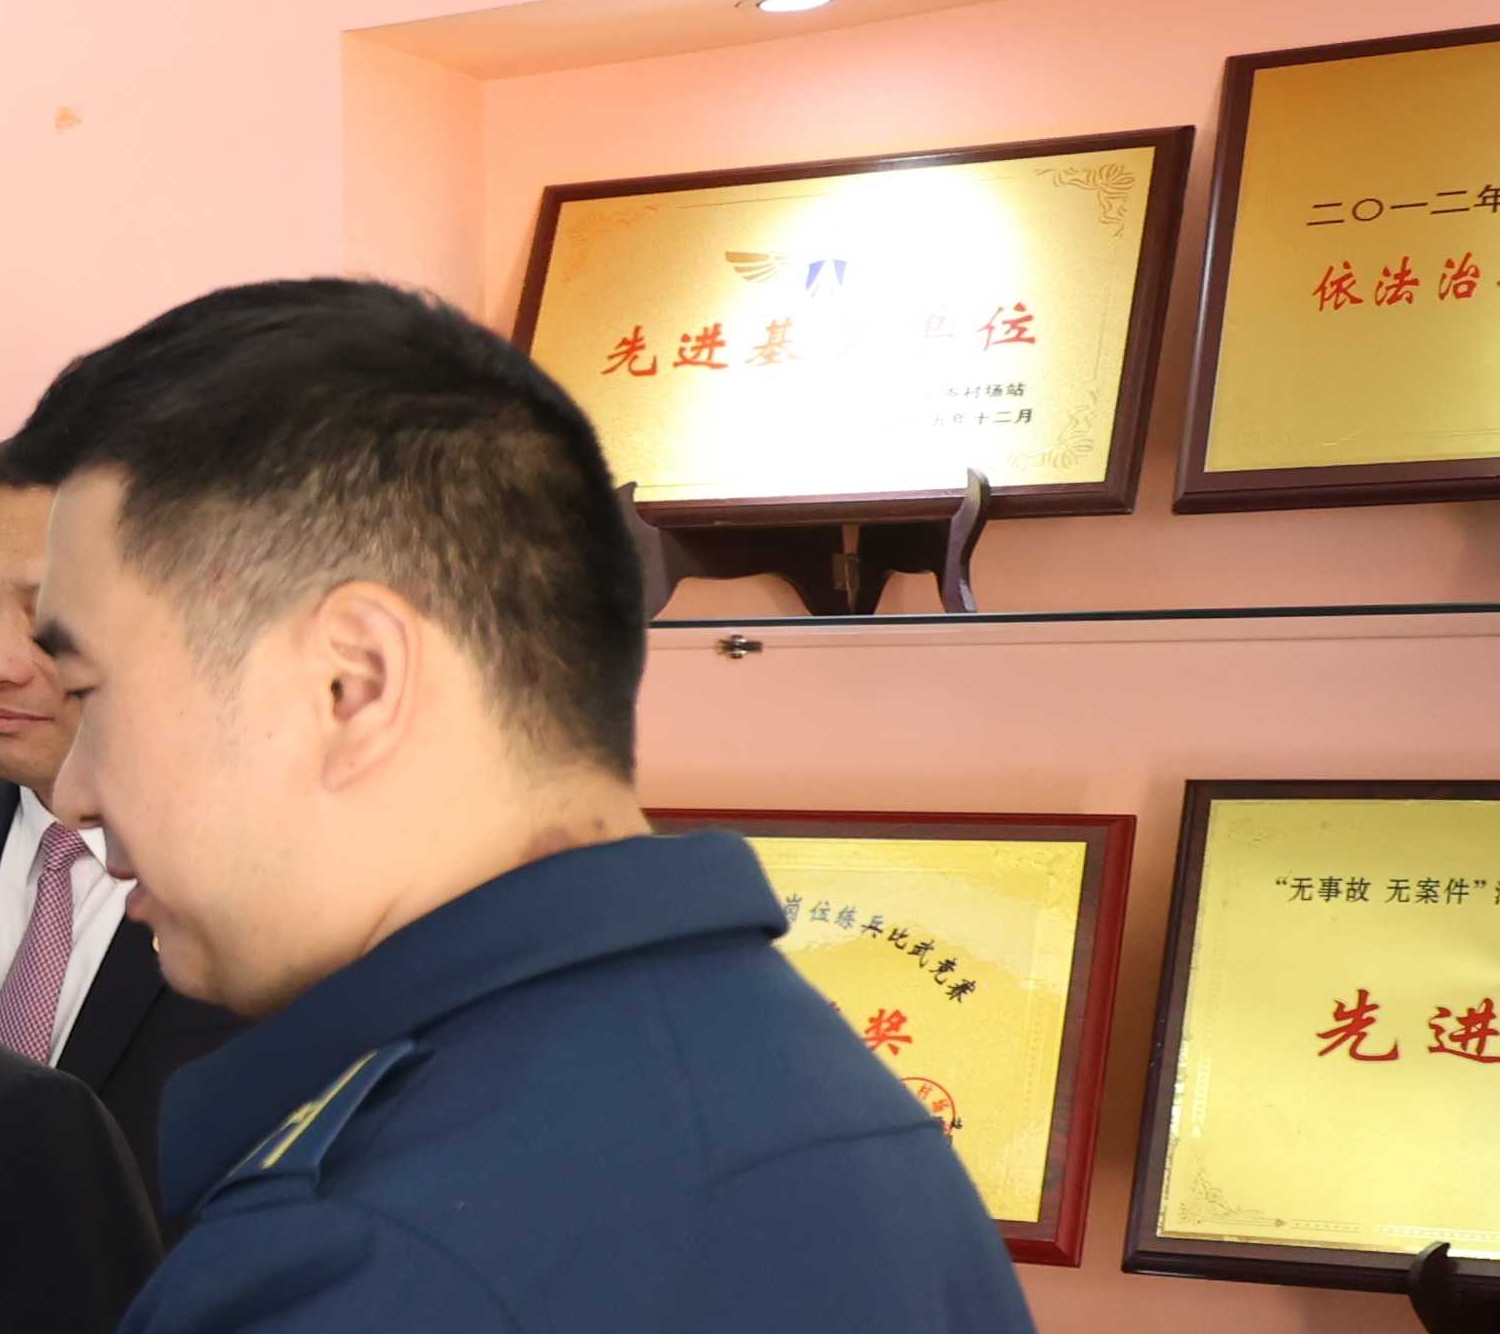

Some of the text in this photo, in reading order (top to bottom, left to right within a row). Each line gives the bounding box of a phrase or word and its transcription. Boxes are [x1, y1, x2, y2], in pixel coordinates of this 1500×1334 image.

[1312, 252, 1481, 312] 依法治
[862, 1007, 913, 1056] 奖
[1316, 988, 1500, 1063] 先进
